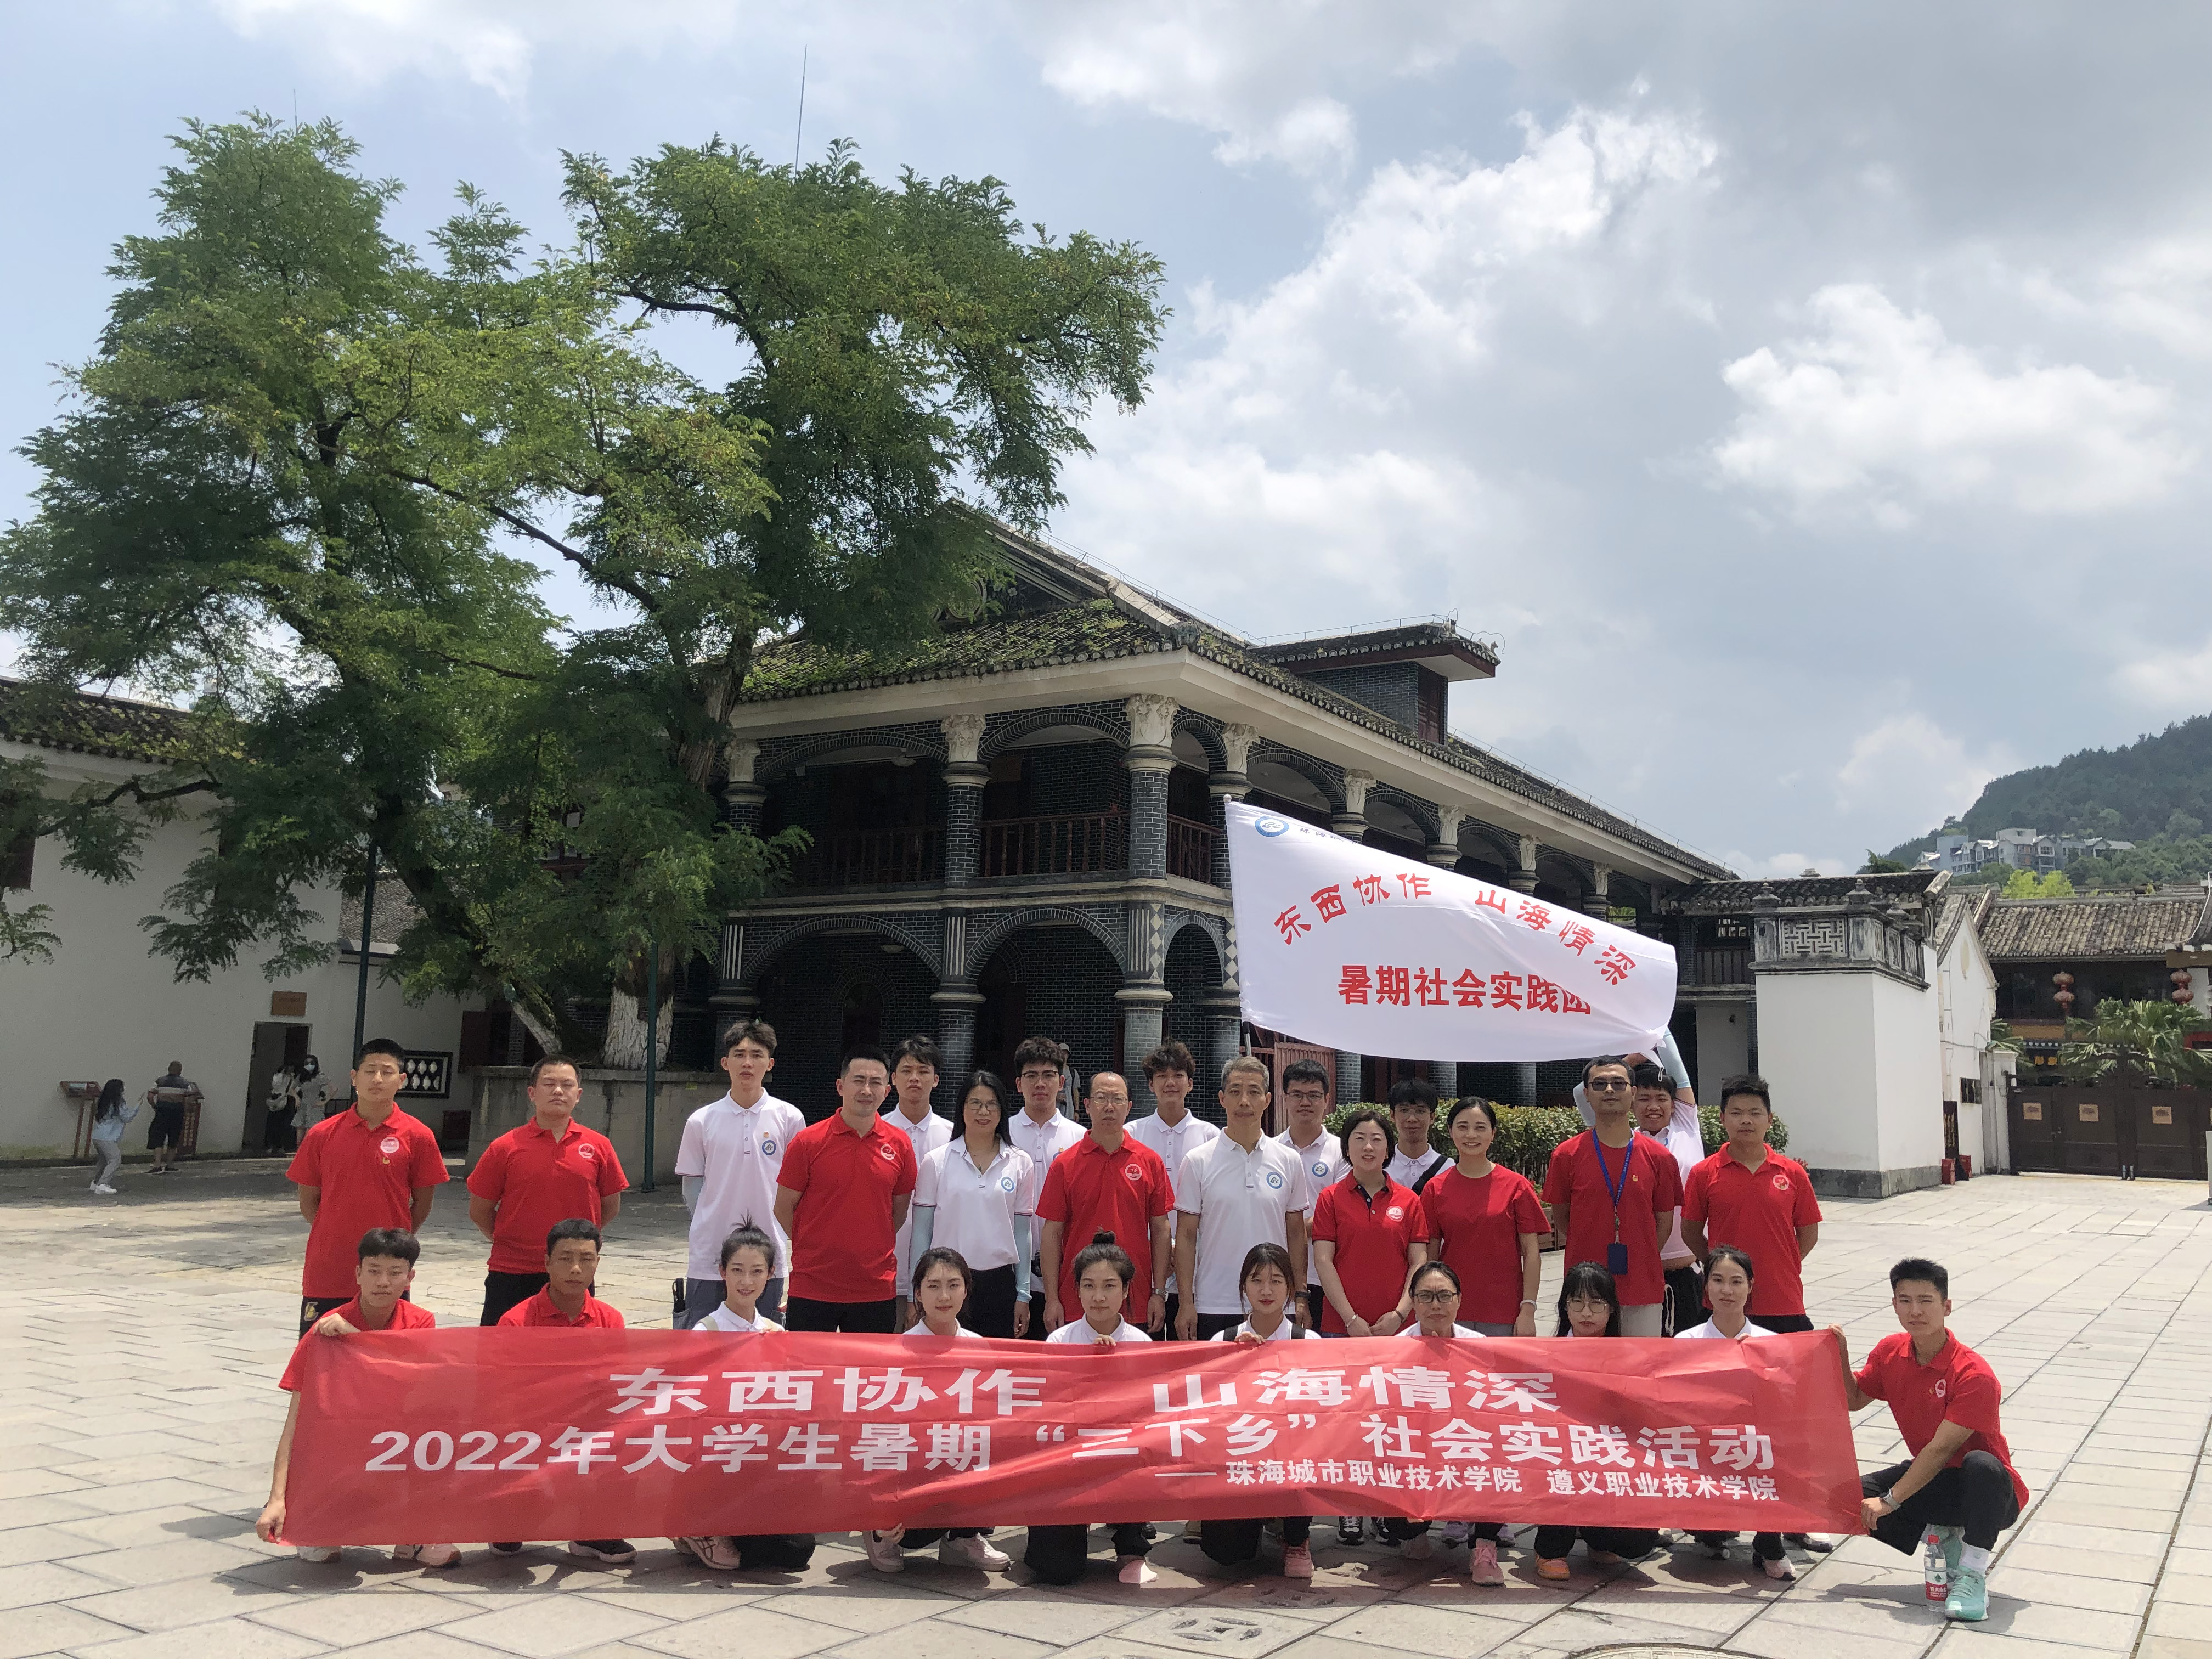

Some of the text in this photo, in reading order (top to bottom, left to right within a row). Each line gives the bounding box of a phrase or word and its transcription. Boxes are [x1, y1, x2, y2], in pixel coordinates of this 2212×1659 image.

[1274, 873, 1636, 986] 东西协作 山海情深
[1338, 965, 1590, 1014] 暑期社会实践团
[607, 1365, 1561, 1415] 东西协作 山海情深
[1546, 1468, 1779, 1501] 遵义职业技术学院
